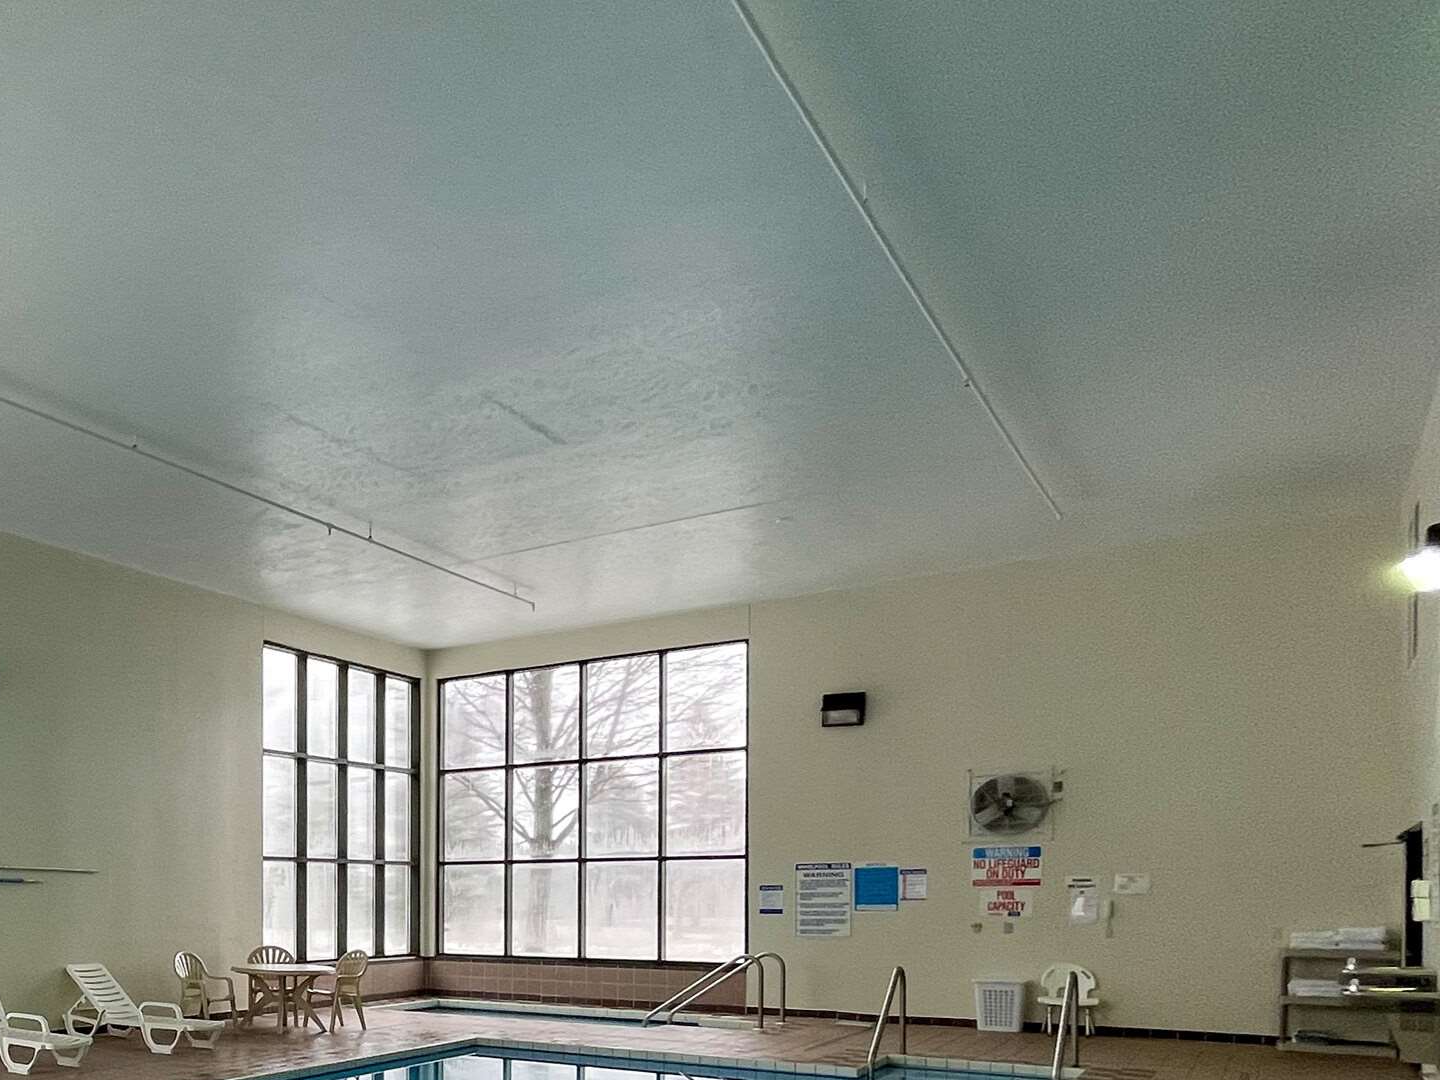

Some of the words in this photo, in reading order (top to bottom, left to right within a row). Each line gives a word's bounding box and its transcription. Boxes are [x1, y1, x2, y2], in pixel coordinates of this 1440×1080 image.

[985, 847, 1029, 858] WARNING
[973, 860, 985, 869] NO
[988, 859, 1040, 869] LIFEGUARD
[986, 869, 998, 878] ON
[1002, 868, 1026, 878] DUTY
[997, 890, 1014, 900] POOL
[987, 902, 1026, 911] CAPACITY
